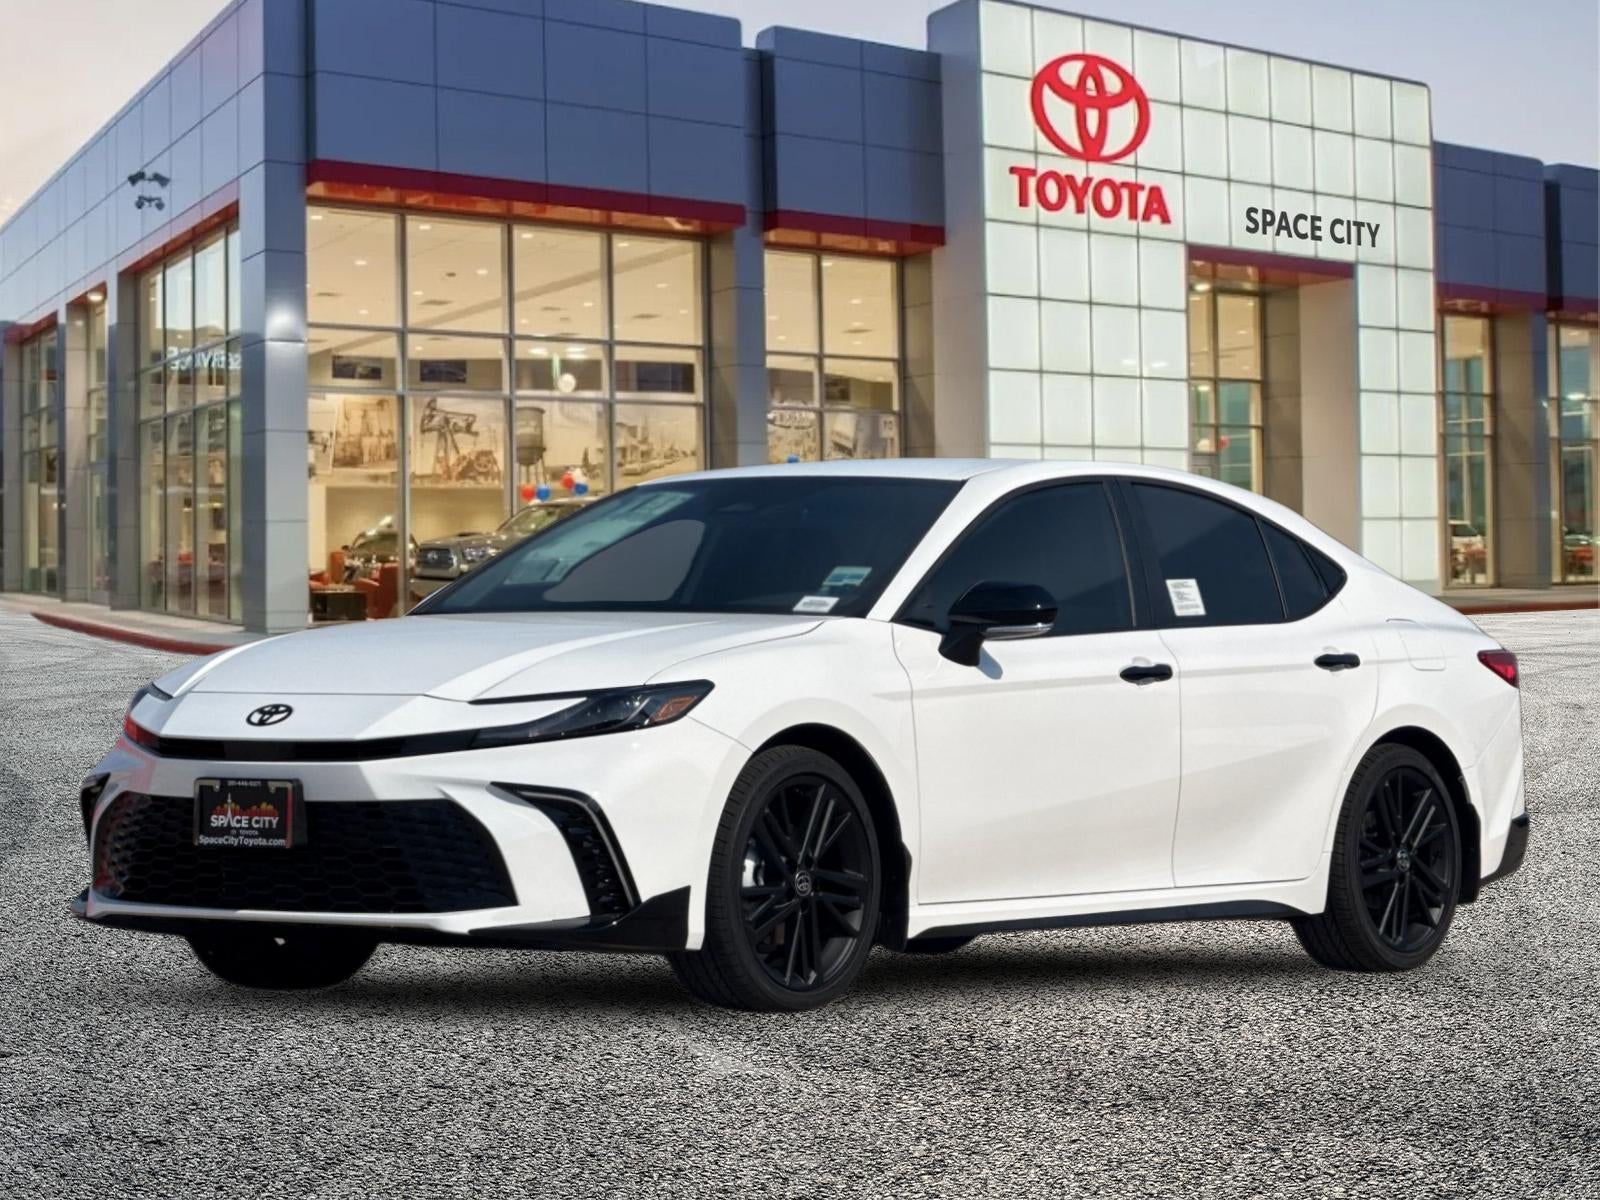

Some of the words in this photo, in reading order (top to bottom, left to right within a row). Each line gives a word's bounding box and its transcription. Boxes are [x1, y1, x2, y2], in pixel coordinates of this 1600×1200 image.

[1009, 166, 1171, 225] TOYOTA
[1245, 206, 1323, 242] SPACE
[1329, 219, 1381, 248] CITY
[210, 814, 249, 828] SPACE
[251, 816, 279, 829] CITY
[199, 834, 286, 847] SpaceCityToyota.com
